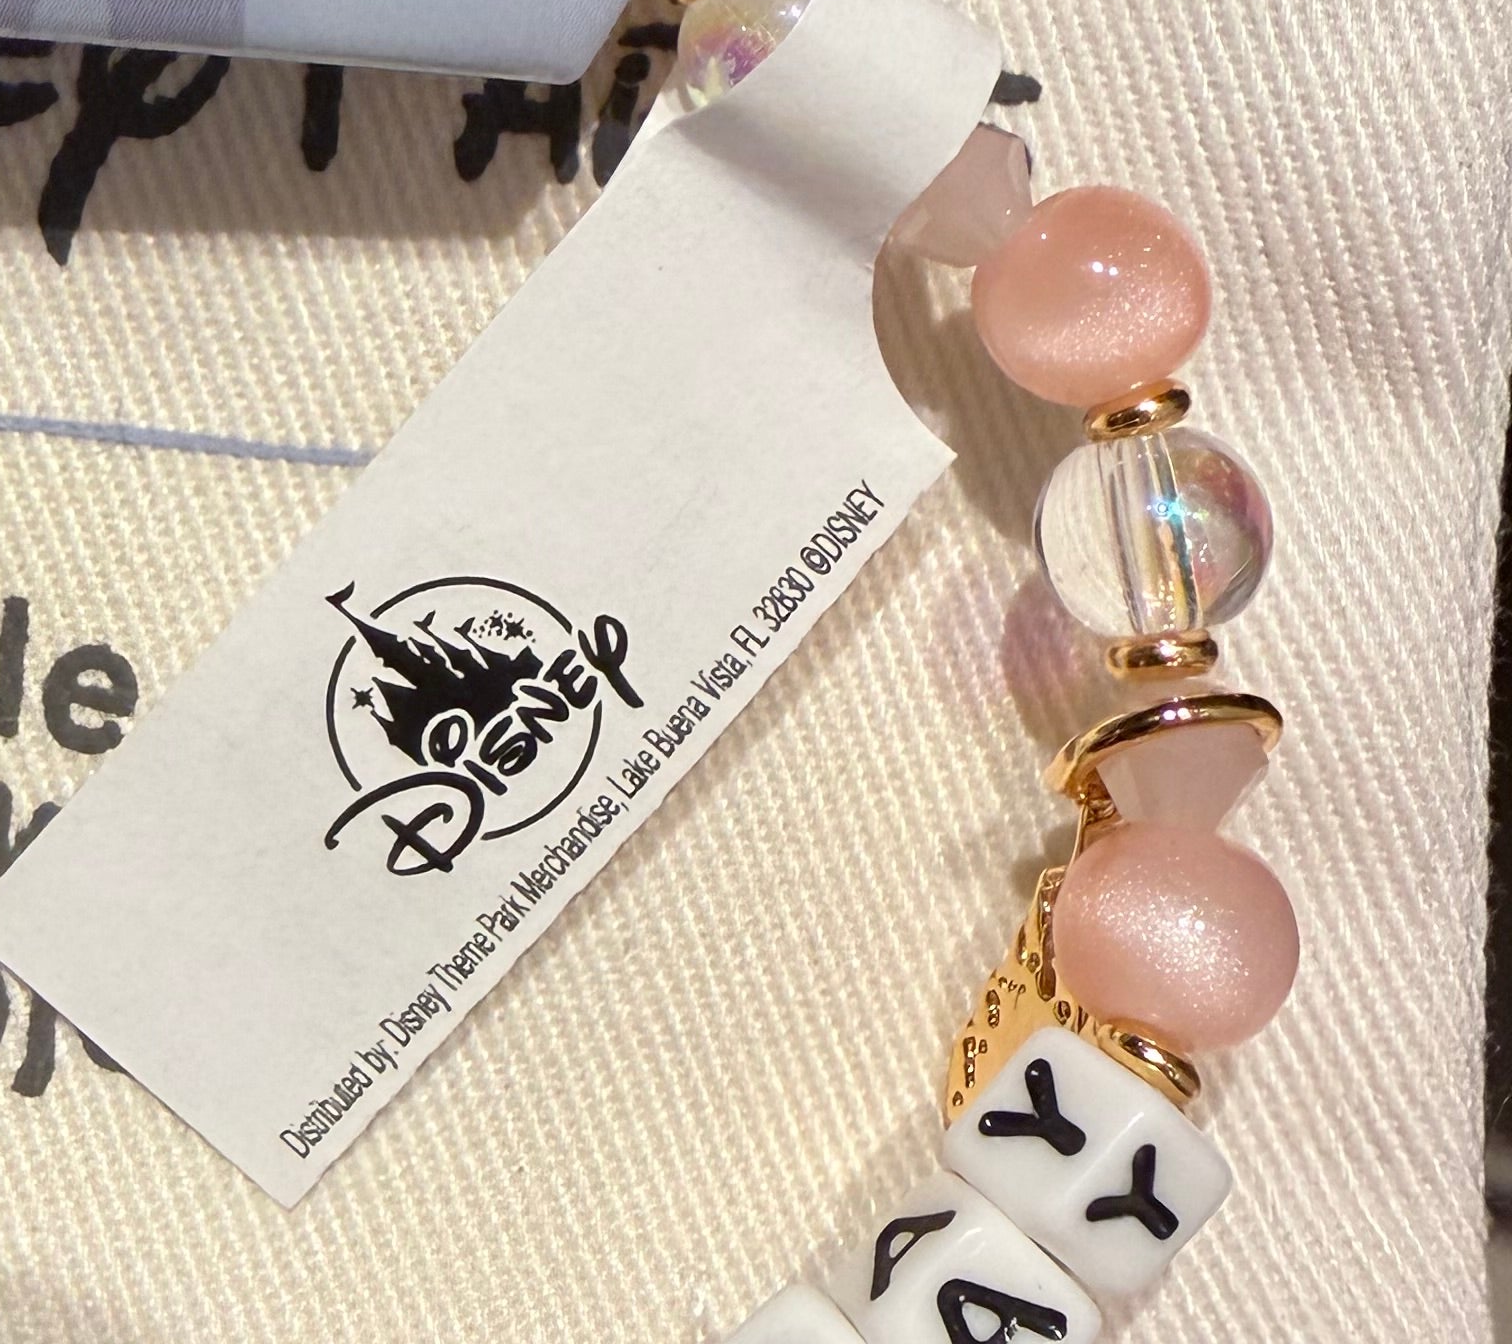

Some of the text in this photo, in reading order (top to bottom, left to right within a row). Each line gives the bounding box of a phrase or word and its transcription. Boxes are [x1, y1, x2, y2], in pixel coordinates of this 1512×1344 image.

[277, 1060, 375, 1160] Distributed
[376, 981, 453, 1049] Disney
[424, 930, 497, 992] Theme
[473, 893, 532, 943] Park
[508, 793, 631, 906] Merchandise,
[604, 748, 662, 801] Lake
[640, 693, 712, 760] Buena
[688, 651, 754, 701] Vista,
[727, 622, 772, 658] FL
